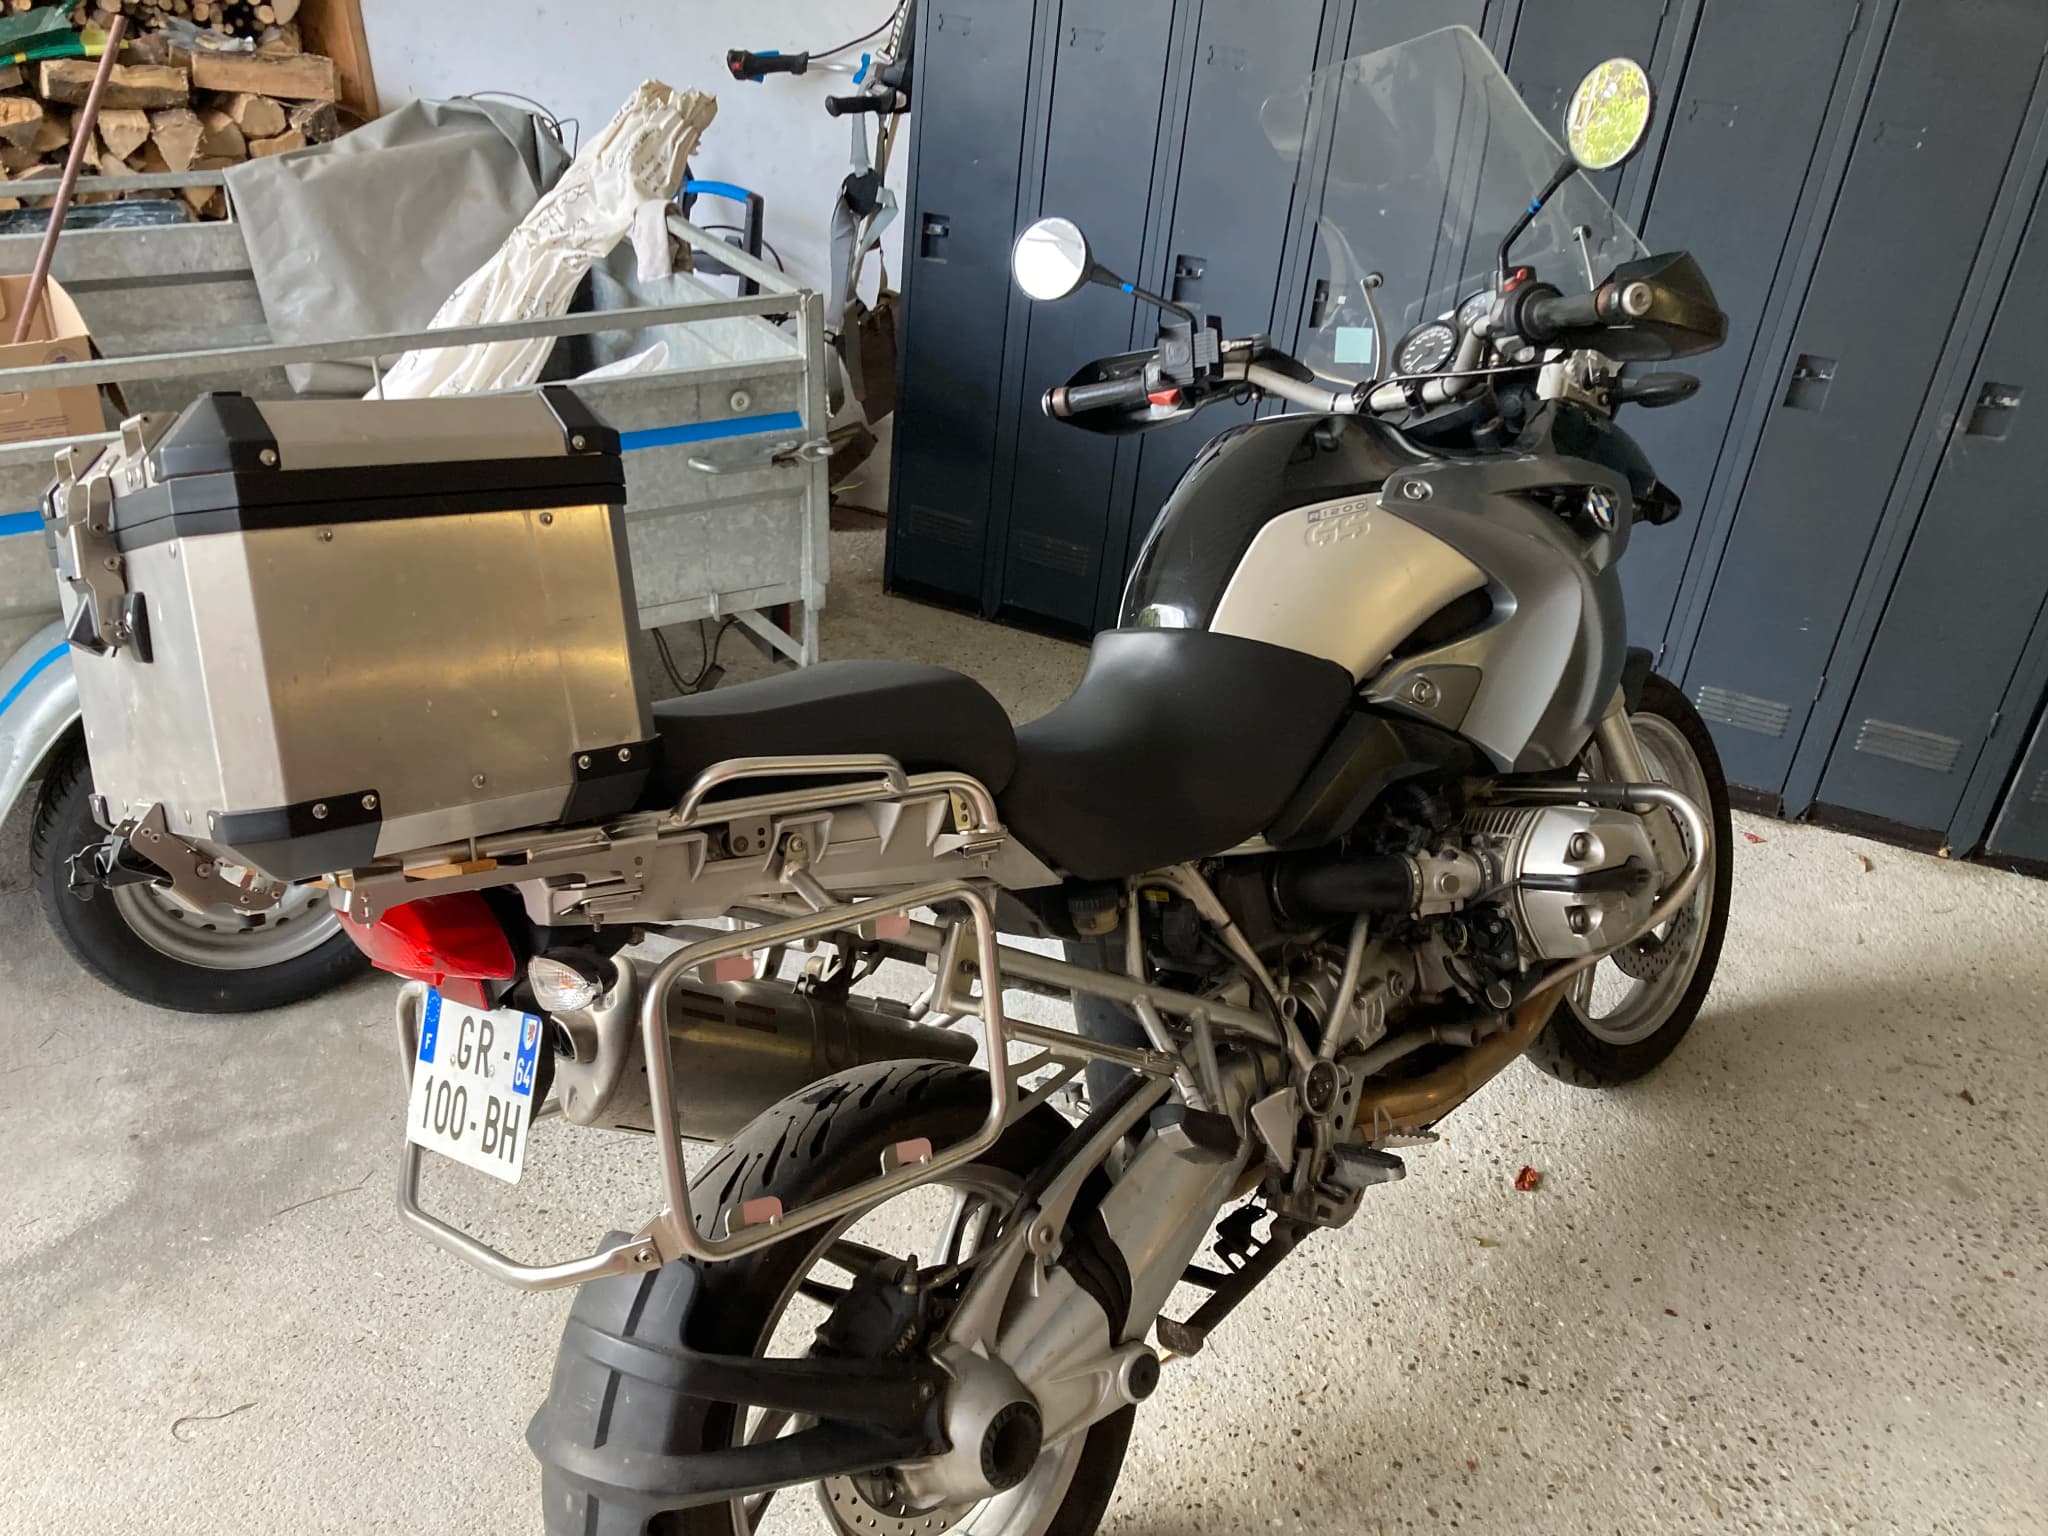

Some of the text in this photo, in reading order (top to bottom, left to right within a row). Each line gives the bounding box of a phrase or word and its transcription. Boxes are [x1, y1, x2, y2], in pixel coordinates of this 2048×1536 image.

[425, 1033, 433, 1050] F
[515, 1057, 532, 1089] 64
[422, 1075, 521, 1164] 100-BH
